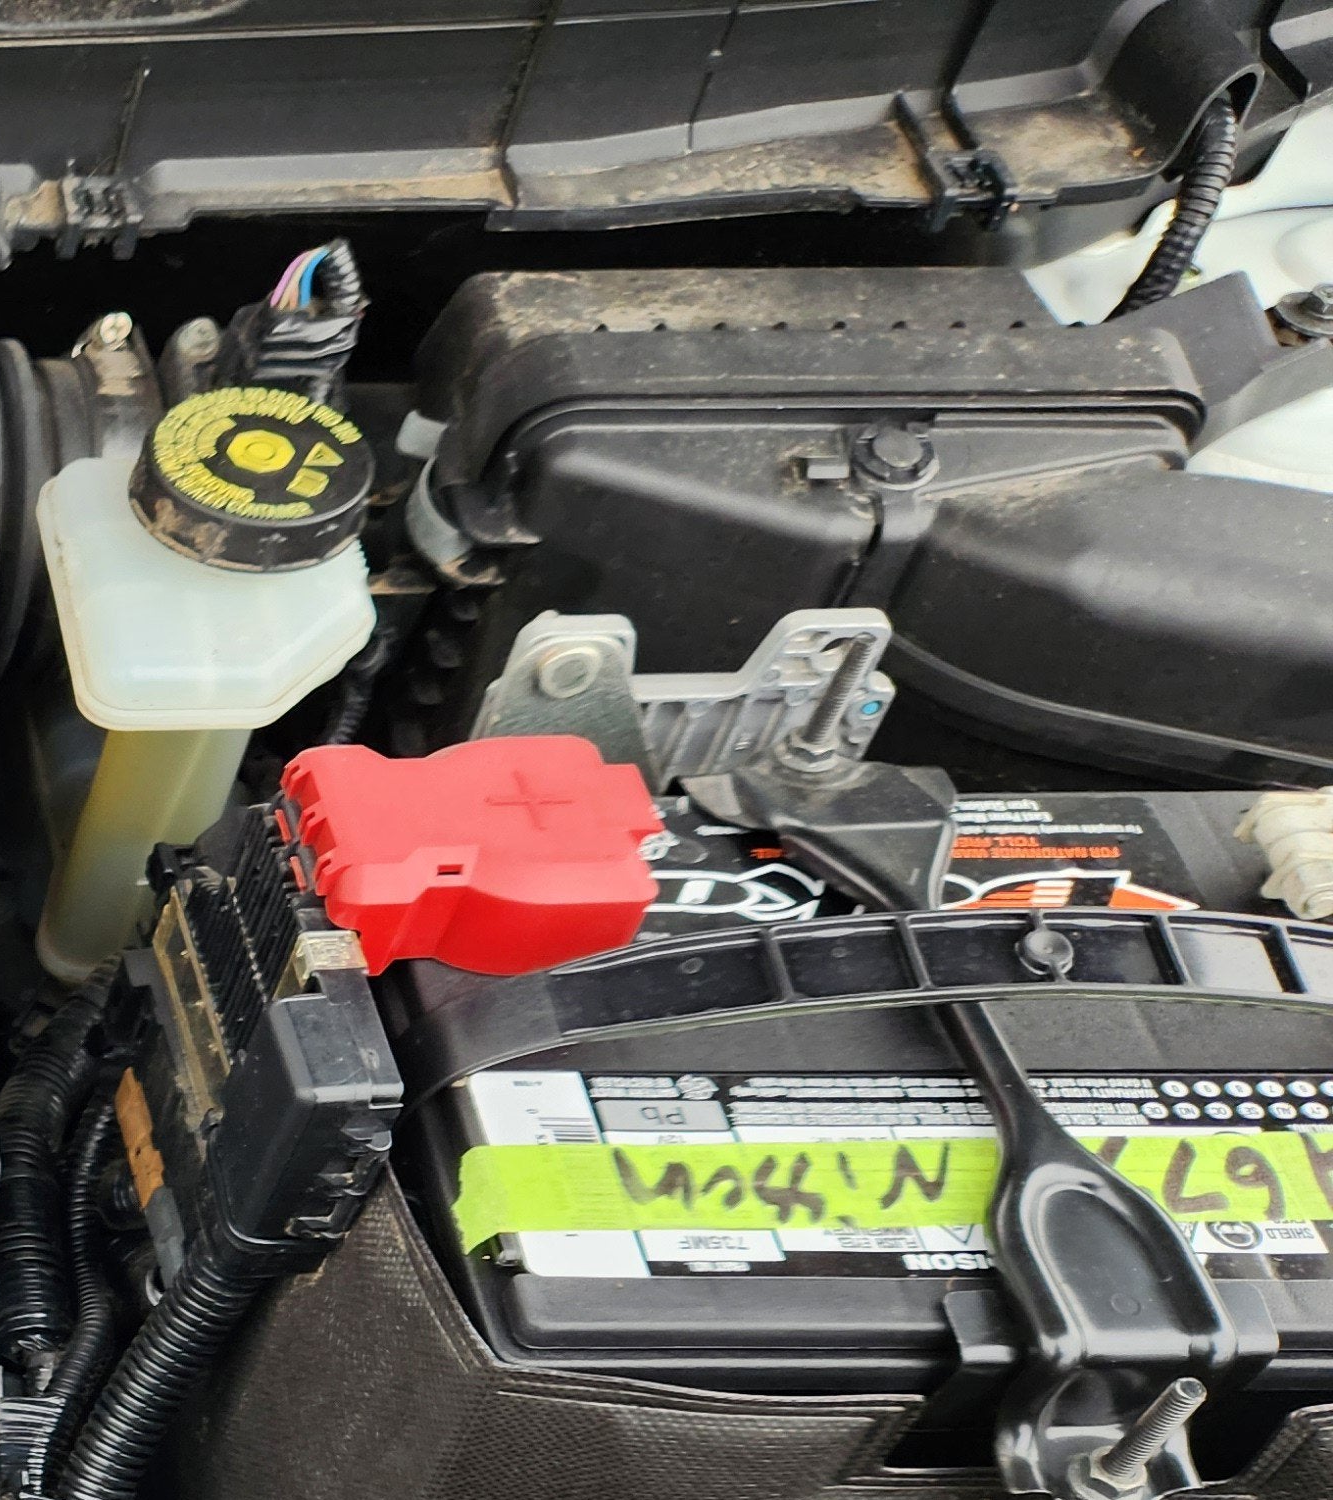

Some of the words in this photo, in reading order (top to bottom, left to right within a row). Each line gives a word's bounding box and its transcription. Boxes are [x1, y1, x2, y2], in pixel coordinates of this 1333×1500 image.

[641, 1107, 686, 1127] Pb
[1266, 1226, 1316, 1241] SHIELD
[903, 1253, 993, 1271] ISON
